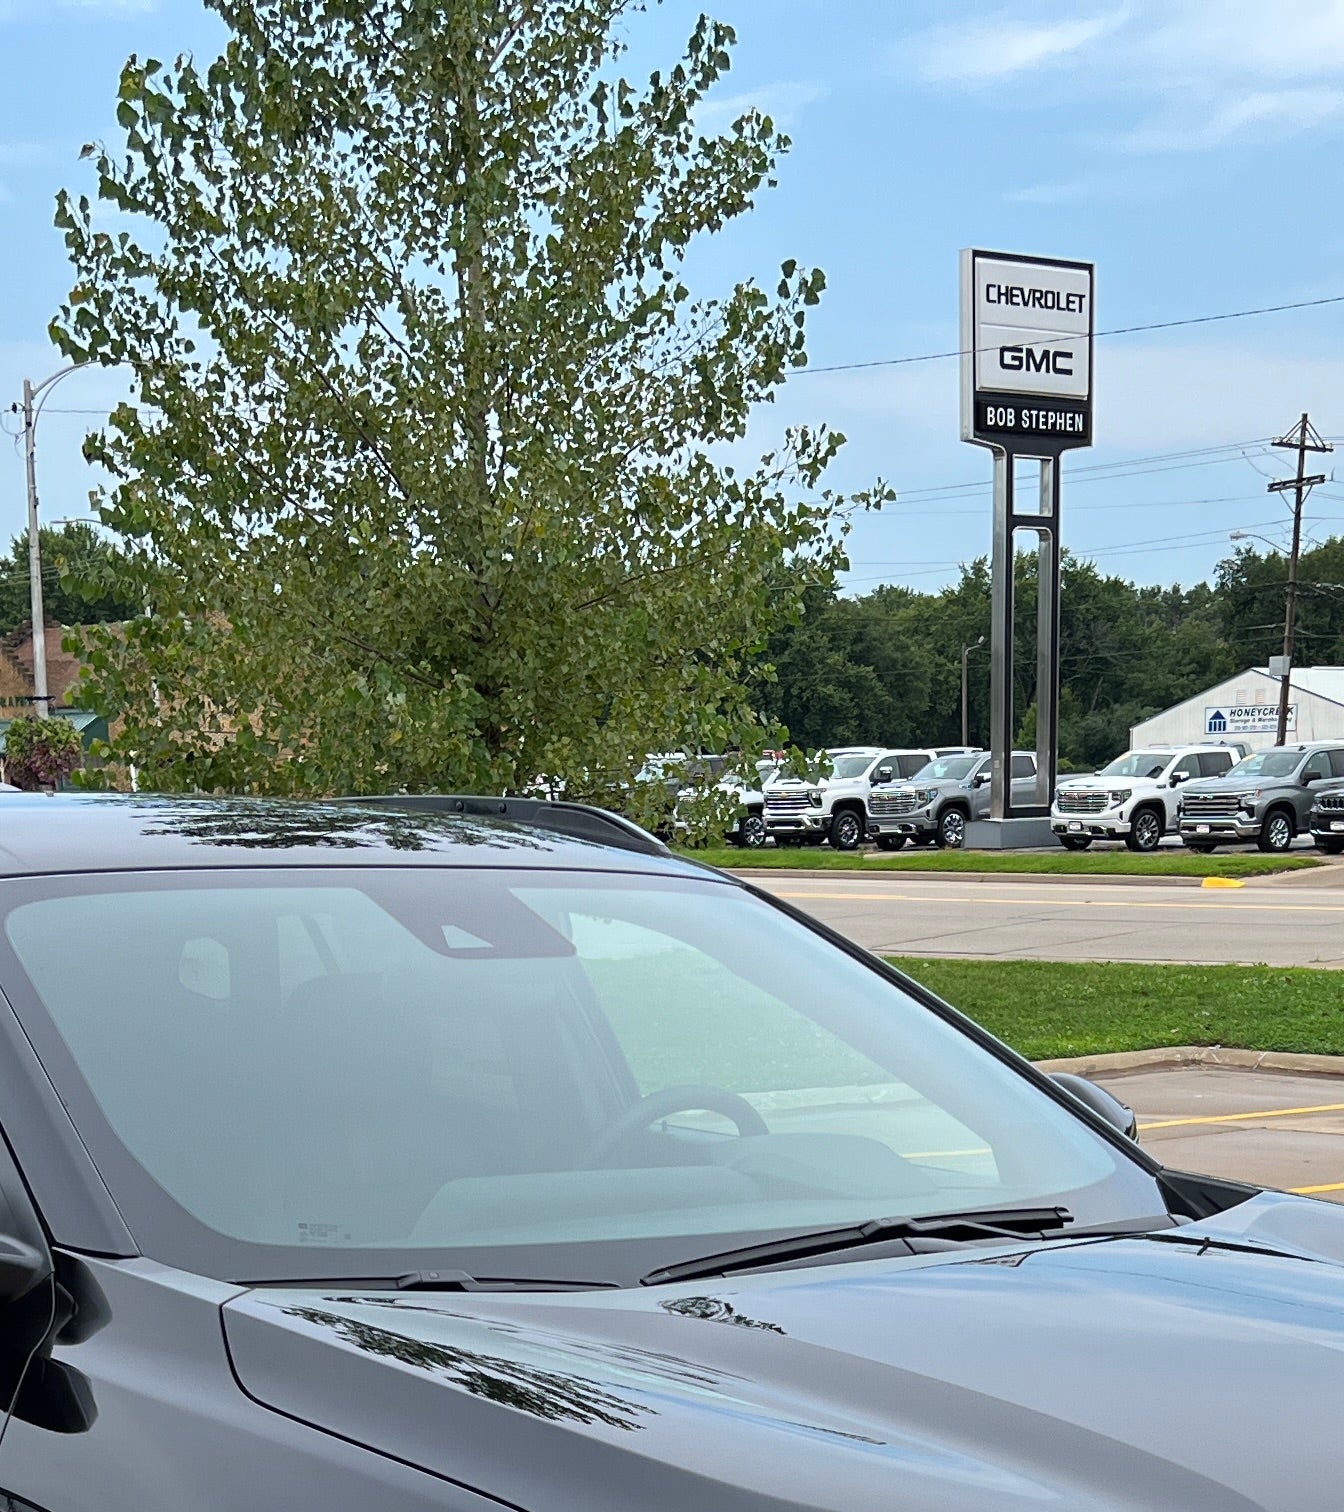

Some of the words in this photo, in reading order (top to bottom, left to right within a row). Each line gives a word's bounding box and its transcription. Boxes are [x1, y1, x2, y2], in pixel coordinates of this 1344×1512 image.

[986, 283, 1086, 313] CHEVROLET
[999, 345, 1073, 376] GMC
[986, 406, 1015, 427] BOB
[1021, 409, 1083, 432] STEPHEN
[1229, 706, 1294, 717] HONEYCREK
